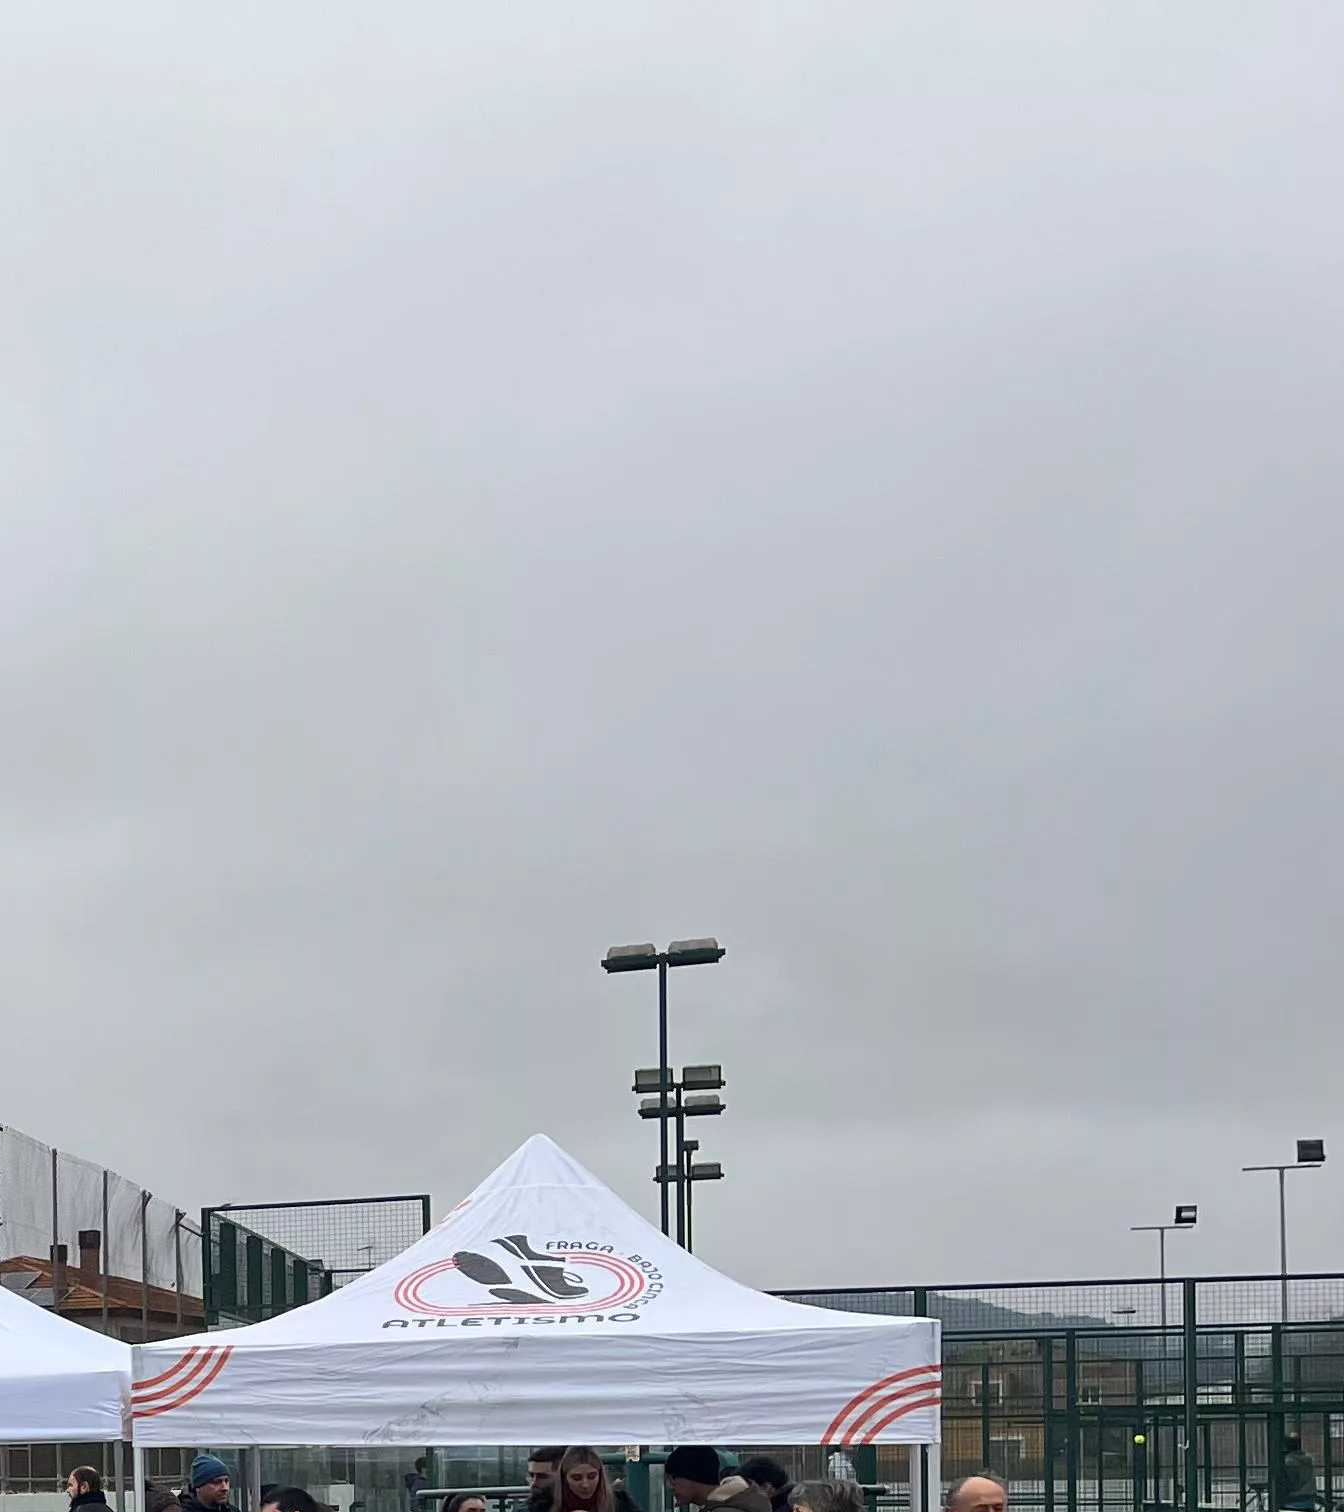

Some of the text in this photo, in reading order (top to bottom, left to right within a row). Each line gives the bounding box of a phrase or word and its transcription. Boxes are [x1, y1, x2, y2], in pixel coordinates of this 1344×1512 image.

[545, 1240, 614, 1253] FRAGA
[627, 1254, 663, 1280] BAJO
[381, 1313, 641, 1328] ATLETISMO
